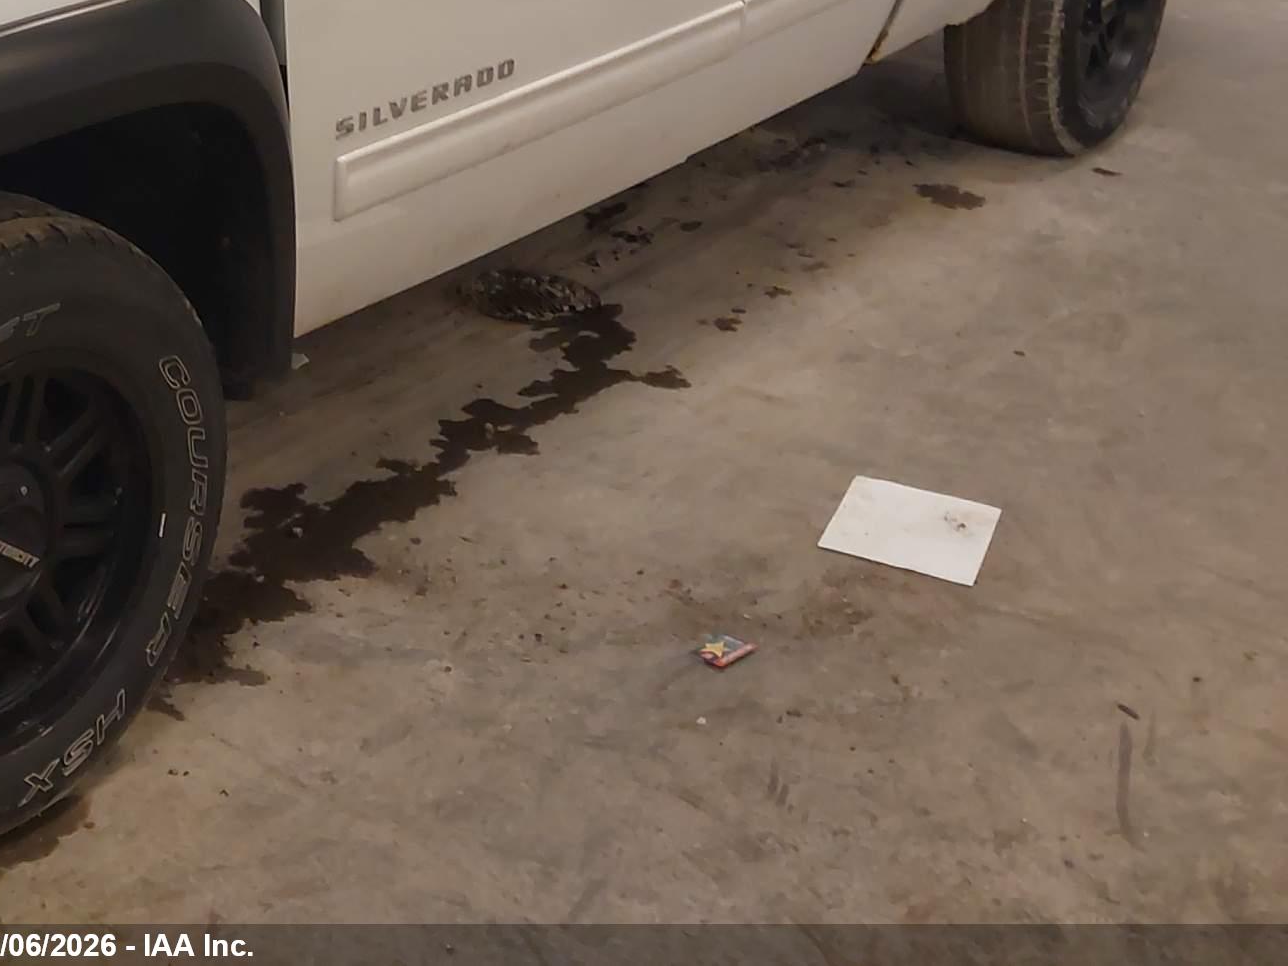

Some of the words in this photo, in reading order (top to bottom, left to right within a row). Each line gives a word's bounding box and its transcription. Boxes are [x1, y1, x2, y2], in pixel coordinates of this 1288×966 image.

[335, 58, 516, 140] SILVERADO
[145, 354, 210, 668] COURSER
[17, 689, 127, 807] HSX
